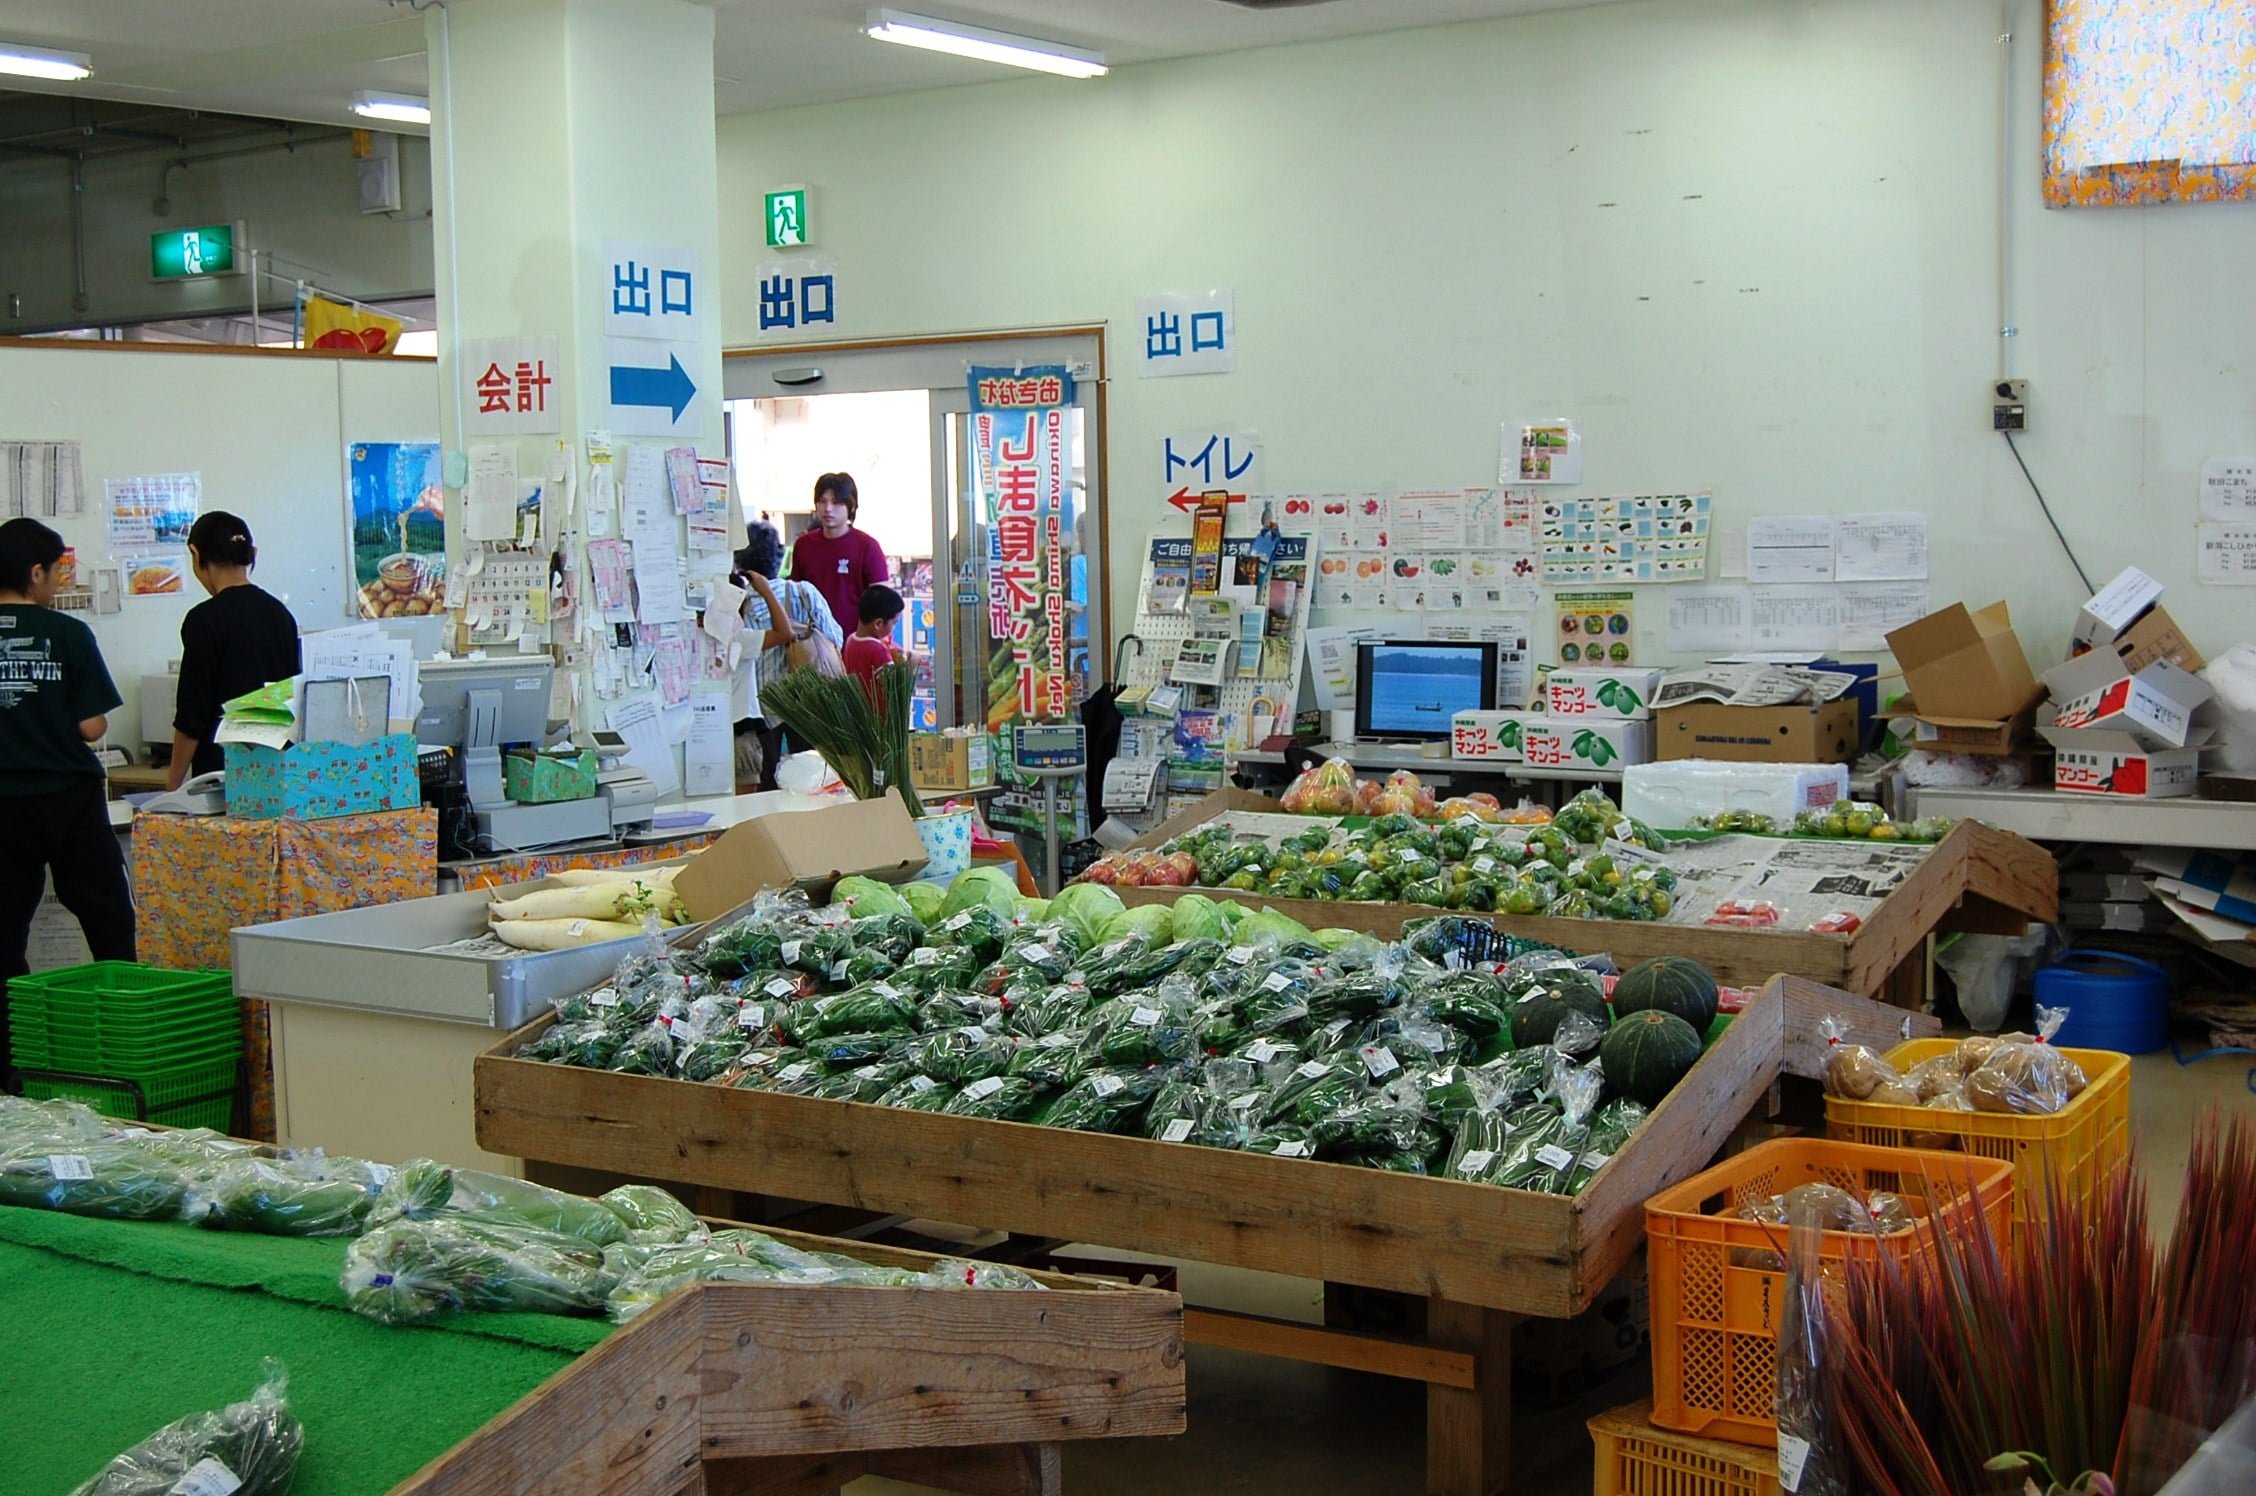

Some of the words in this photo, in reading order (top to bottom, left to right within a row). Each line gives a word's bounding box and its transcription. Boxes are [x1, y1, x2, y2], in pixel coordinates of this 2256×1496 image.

[613, 261, 692, 316] 出口
[760, 275, 834, 330] 出口
[1147, 311, 1224, 360] 出口
[476, 360, 552, 413] 会計
[1165, 434, 1254, 484] トイレ
[0, 661, 28, 679] THE
[31, 662, 62, 680] WIN
[1551, 686, 1585, 698] キーツ
[1552, 700, 1597, 714] マンゴー
[1455, 728, 1487, 740] キーツ
[1456, 742, 1498, 754] マンゴー
[1526, 736, 1560, 749] キーツ
[1526, 751, 1572, 764] マンゴー
[2057, 767, 2098, 782] マンゴー
